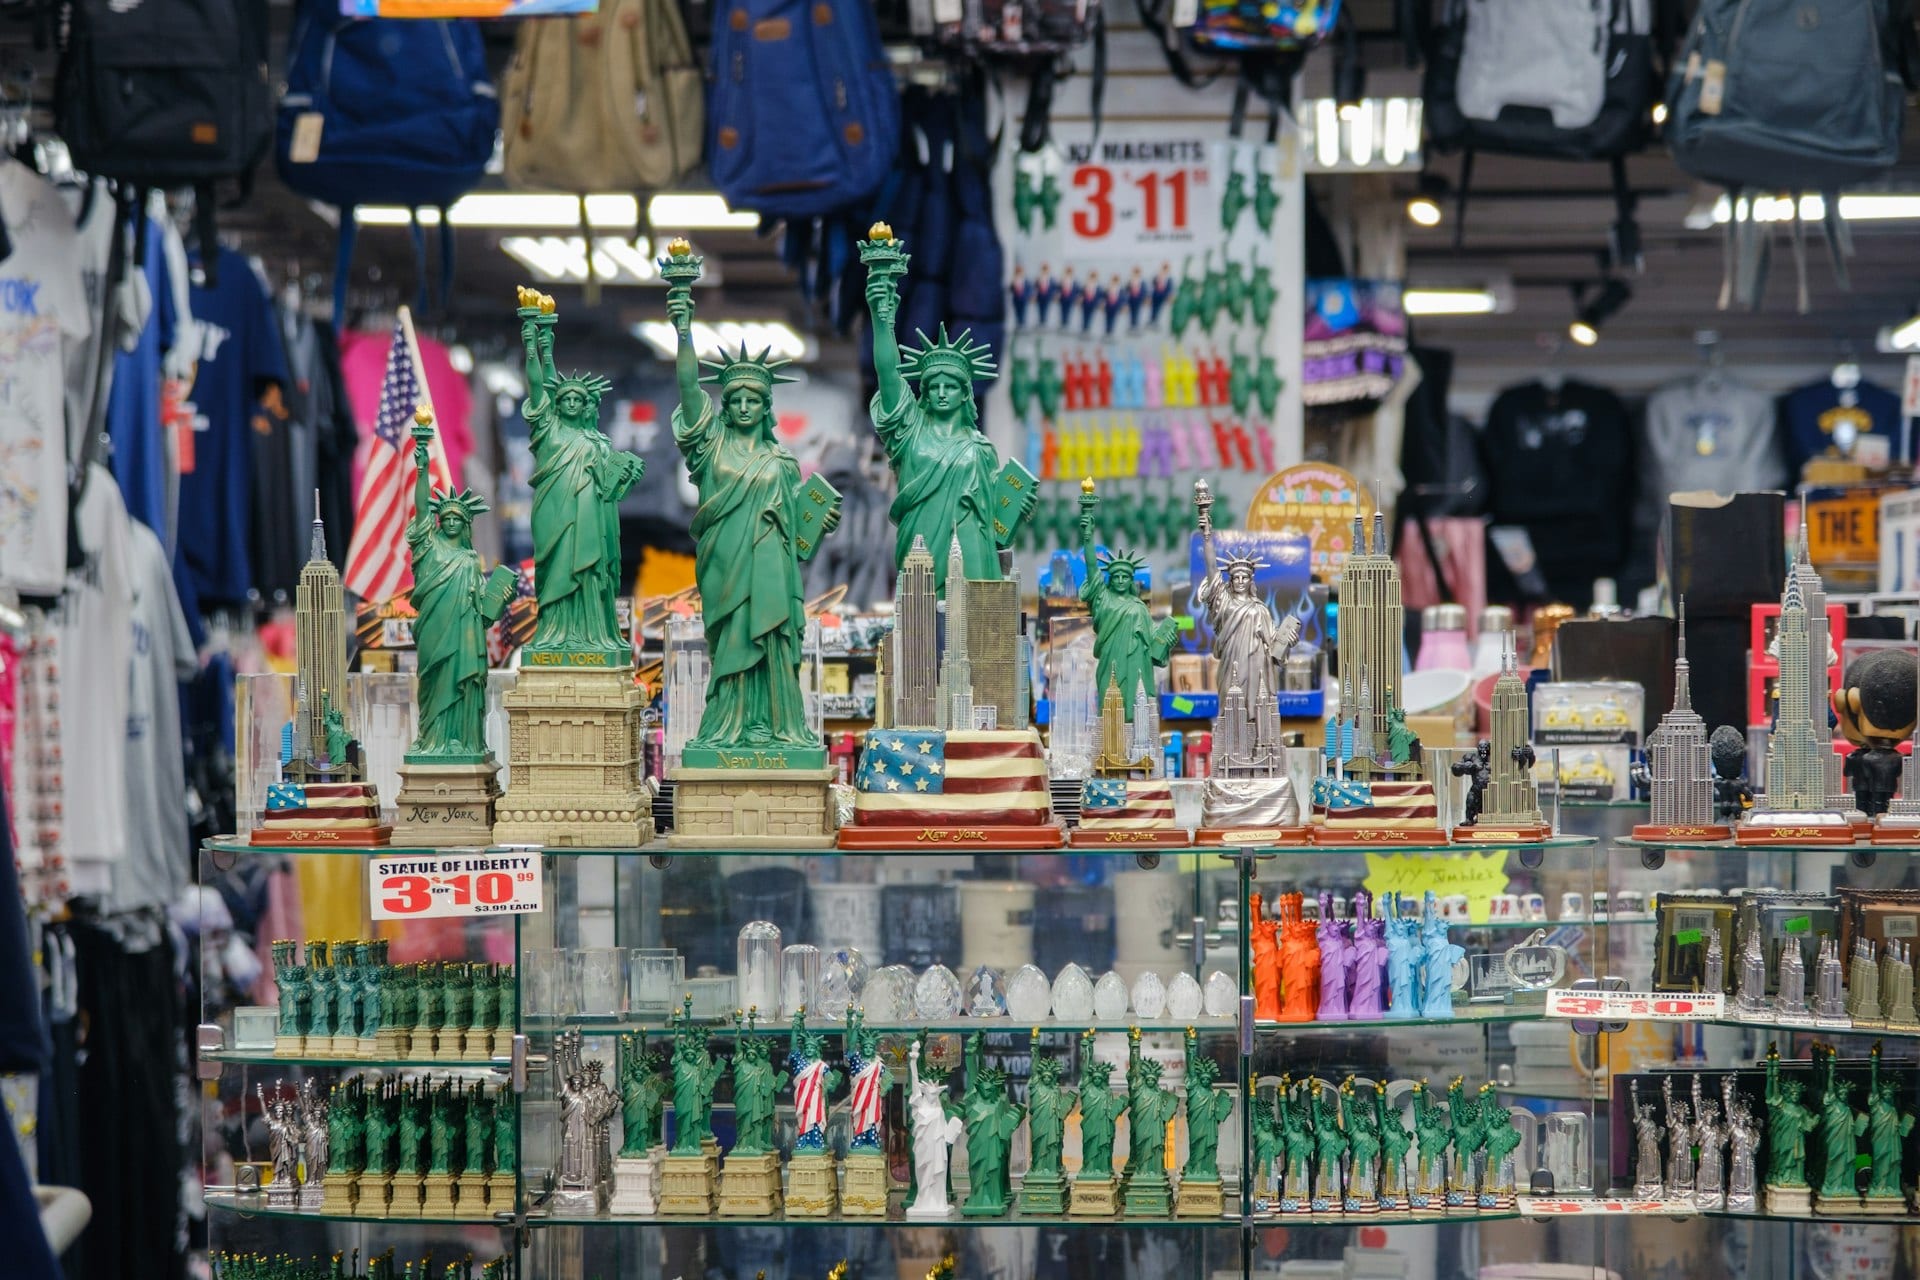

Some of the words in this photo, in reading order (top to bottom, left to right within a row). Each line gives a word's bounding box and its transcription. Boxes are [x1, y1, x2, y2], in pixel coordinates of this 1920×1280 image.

[1072, 165, 1114, 240] 3
[1818, 509, 1863, 545] THE
[531, 653, 563, 666] NEW
[568, 652, 607, 666] YORK
[717, 751, 754, 769] New
[753, 751, 788, 769] York
[379, 861, 438, 875] STATUE
[442, 860, 462, 872] OF
[465, 858, 530, 871] LIBERTY
[382, 875, 432, 913] 3
[475, 904, 508, 912] $3.99
[510, 903, 538, 911] EACH
[1555, 990, 1604, 998] EMPIRE
[1556, 998, 1605, 1015] 3
